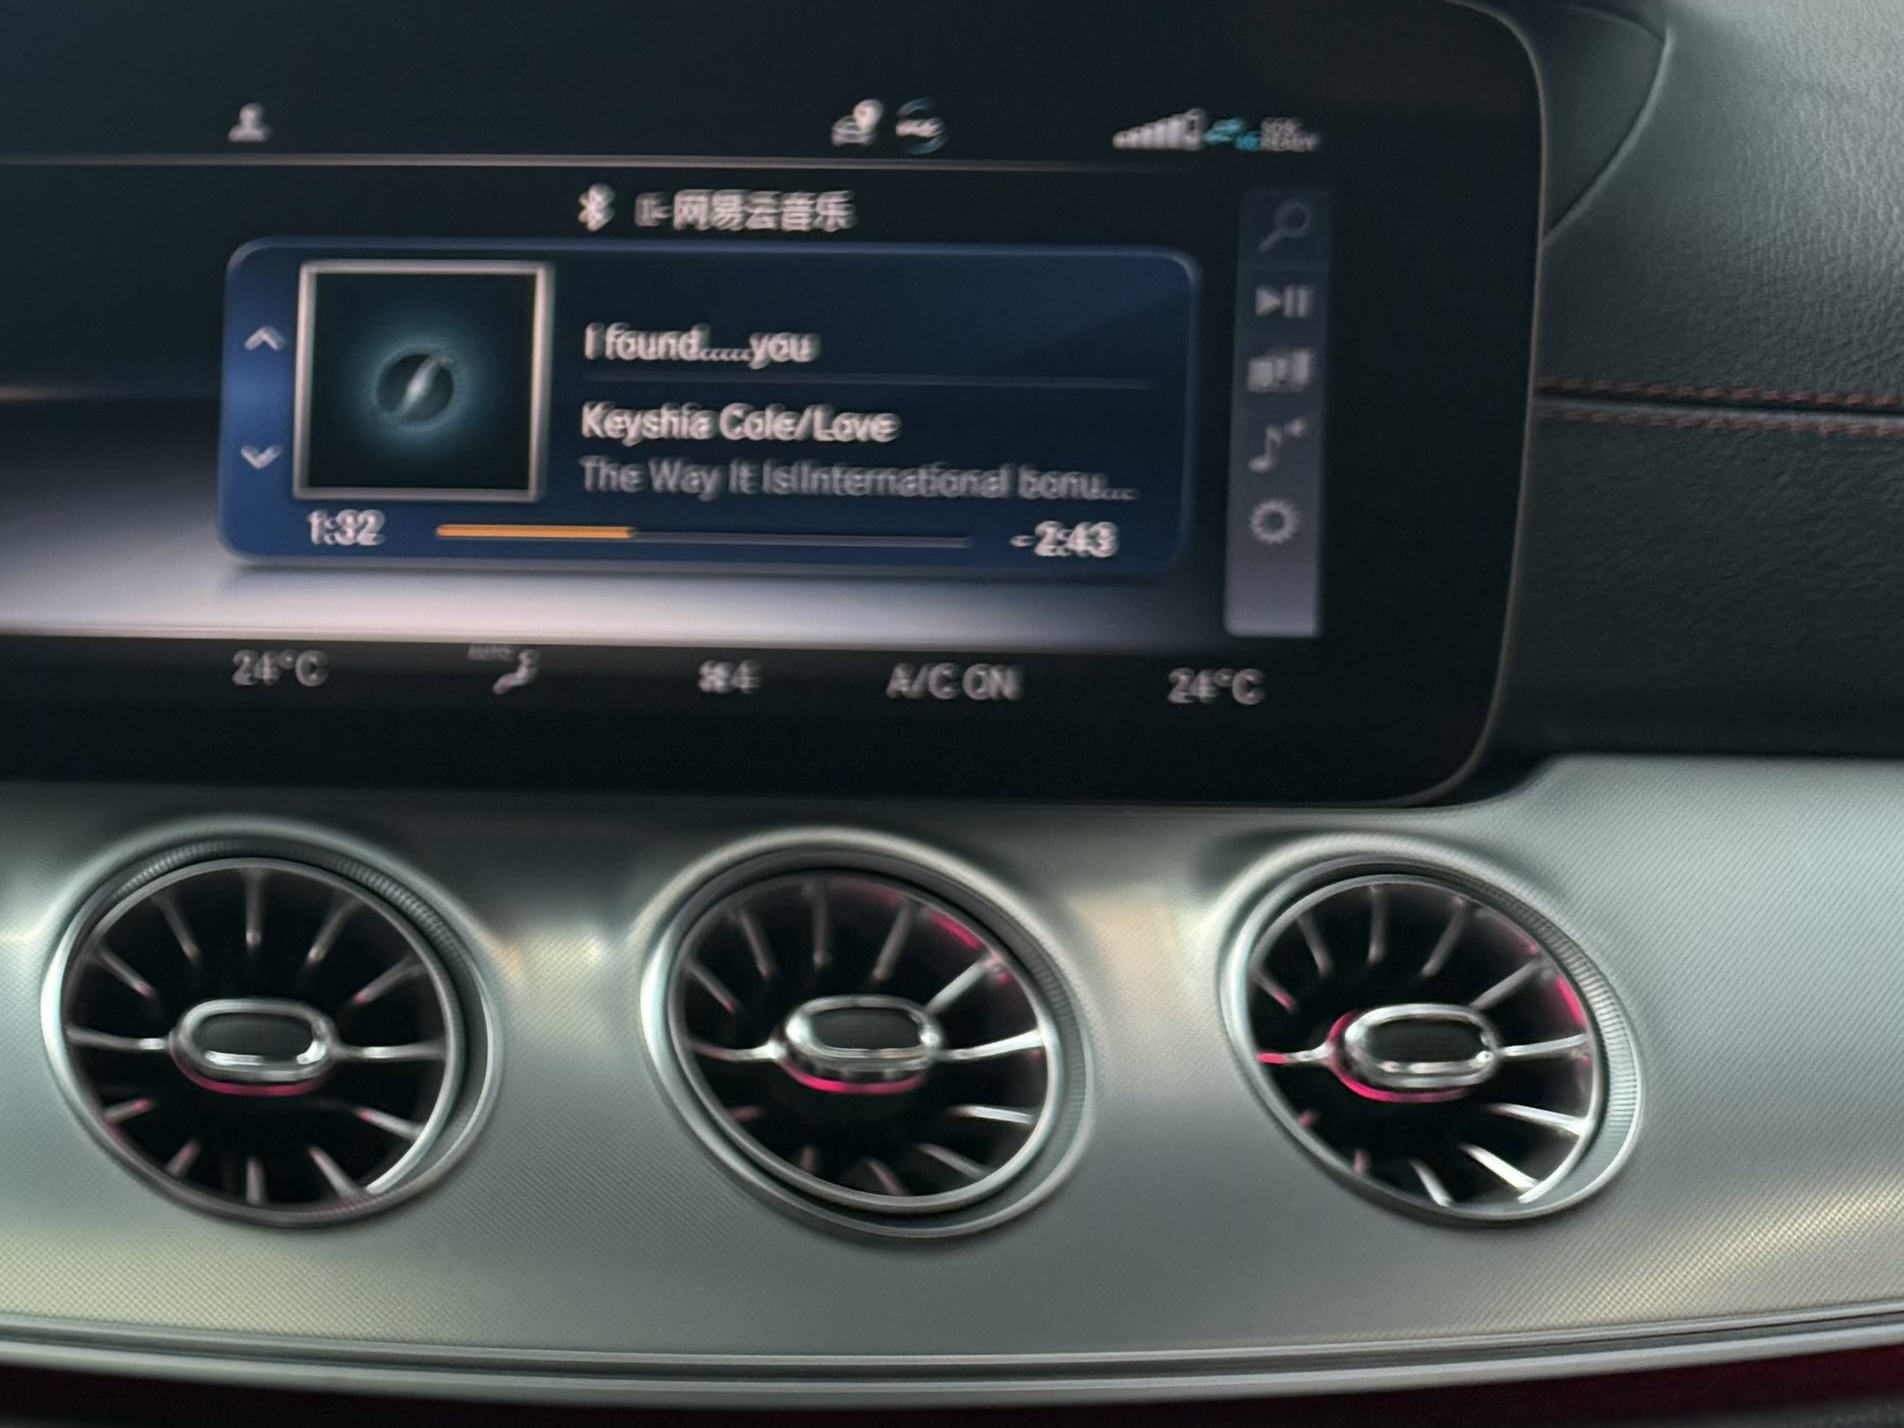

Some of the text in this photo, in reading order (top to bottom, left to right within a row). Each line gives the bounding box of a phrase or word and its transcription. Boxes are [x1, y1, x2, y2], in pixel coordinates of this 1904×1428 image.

[672, 189, 856, 233] 网易云音乐
[584, 322, 603, 360] I
[581, 401, 902, 446] Keyshia Cole/Love
[578, 455, 644, 494] The
[648, 457, 720, 501] Way
[729, 458, 759, 494] It
[308, 509, 387, 548] 1:32
[232, 649, 330, 688] 24°C
[886, 662, 1022, 701] A/C ON
[1166, 666, 1267, 707] 24°C
